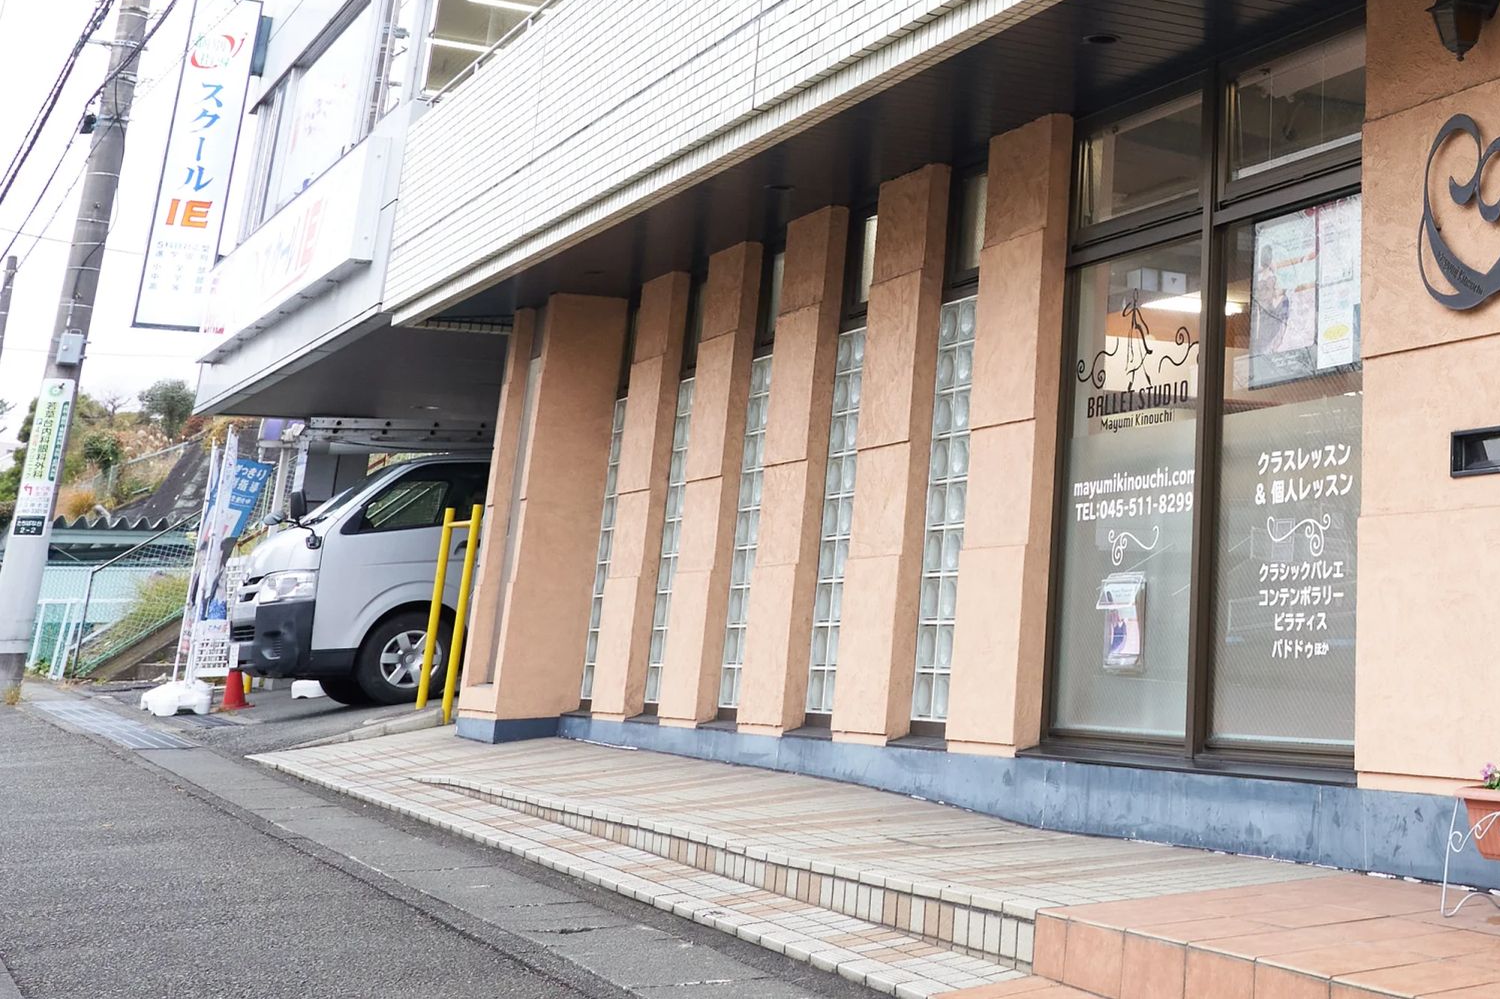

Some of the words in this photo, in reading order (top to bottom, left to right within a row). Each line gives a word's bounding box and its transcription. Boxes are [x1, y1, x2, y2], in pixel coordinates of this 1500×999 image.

[177, 82, 224, 193] スクール
[165, 198, 213, 229] IE
[1087, 390, 1135, 418] BALLET
[1139, 380, 1189, 408] STUDIO
[1101, 416, 1134, 433] Mayumi
[1135, 410, 1173, 426] Kinouchi
[1257, 443, 1351, 475] クラスレッスン
[1255, 483, 1266, 505] &
[1270, 474, 1353, 505] 個人レッスン
[1259, 560, 1344, 583] クラシックバレエ
[1258, 585, 1344, 607] コンテンポラリー
[1274, 612, 1328, 631] ピラティス
